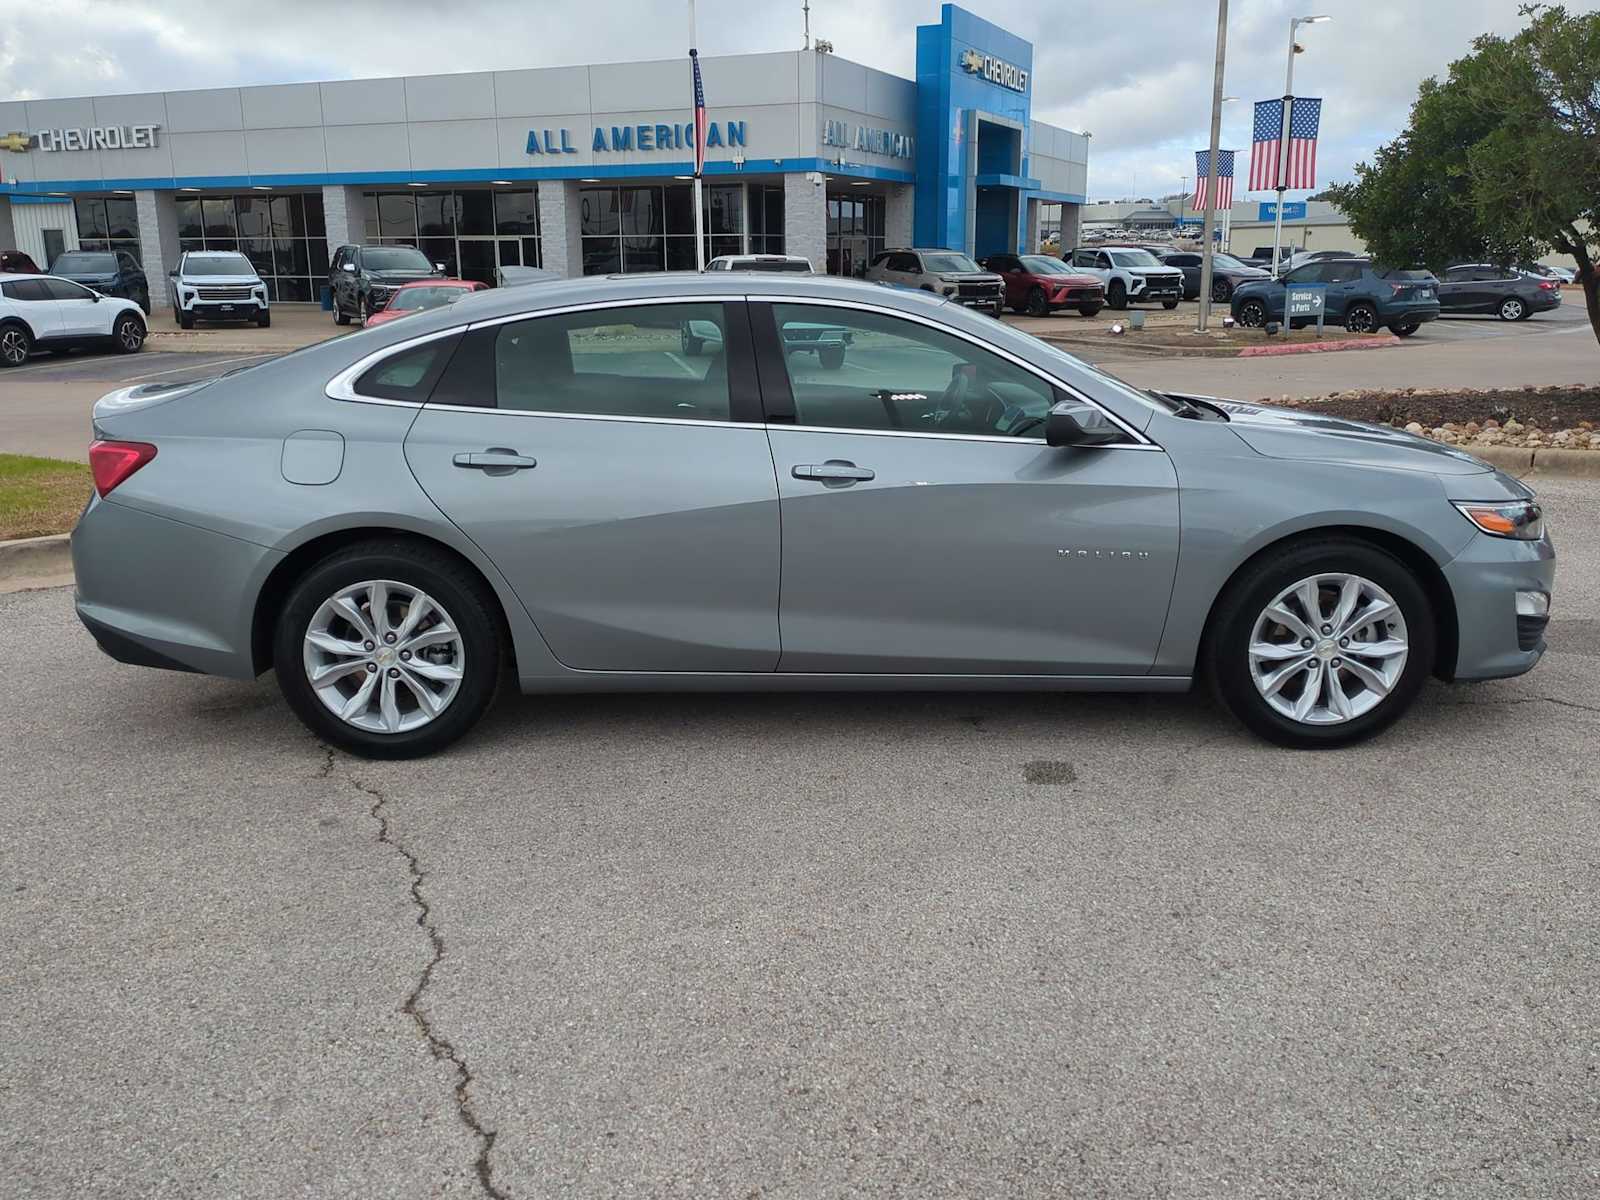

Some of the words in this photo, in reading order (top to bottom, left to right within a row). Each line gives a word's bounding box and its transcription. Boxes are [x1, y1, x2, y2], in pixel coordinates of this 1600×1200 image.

[984, 55, 1029, 93] CHEVROLET
[39, 124, 158, 151] CHEVROLET
[526, 128, 576, 154] ALL
[824, 119, 852, 147] ALL
[1291, 292, 1312, 301] Service
[1296, 303, 1311, 312] Parts
[1057, 548, 1150, 560] MALIBU
